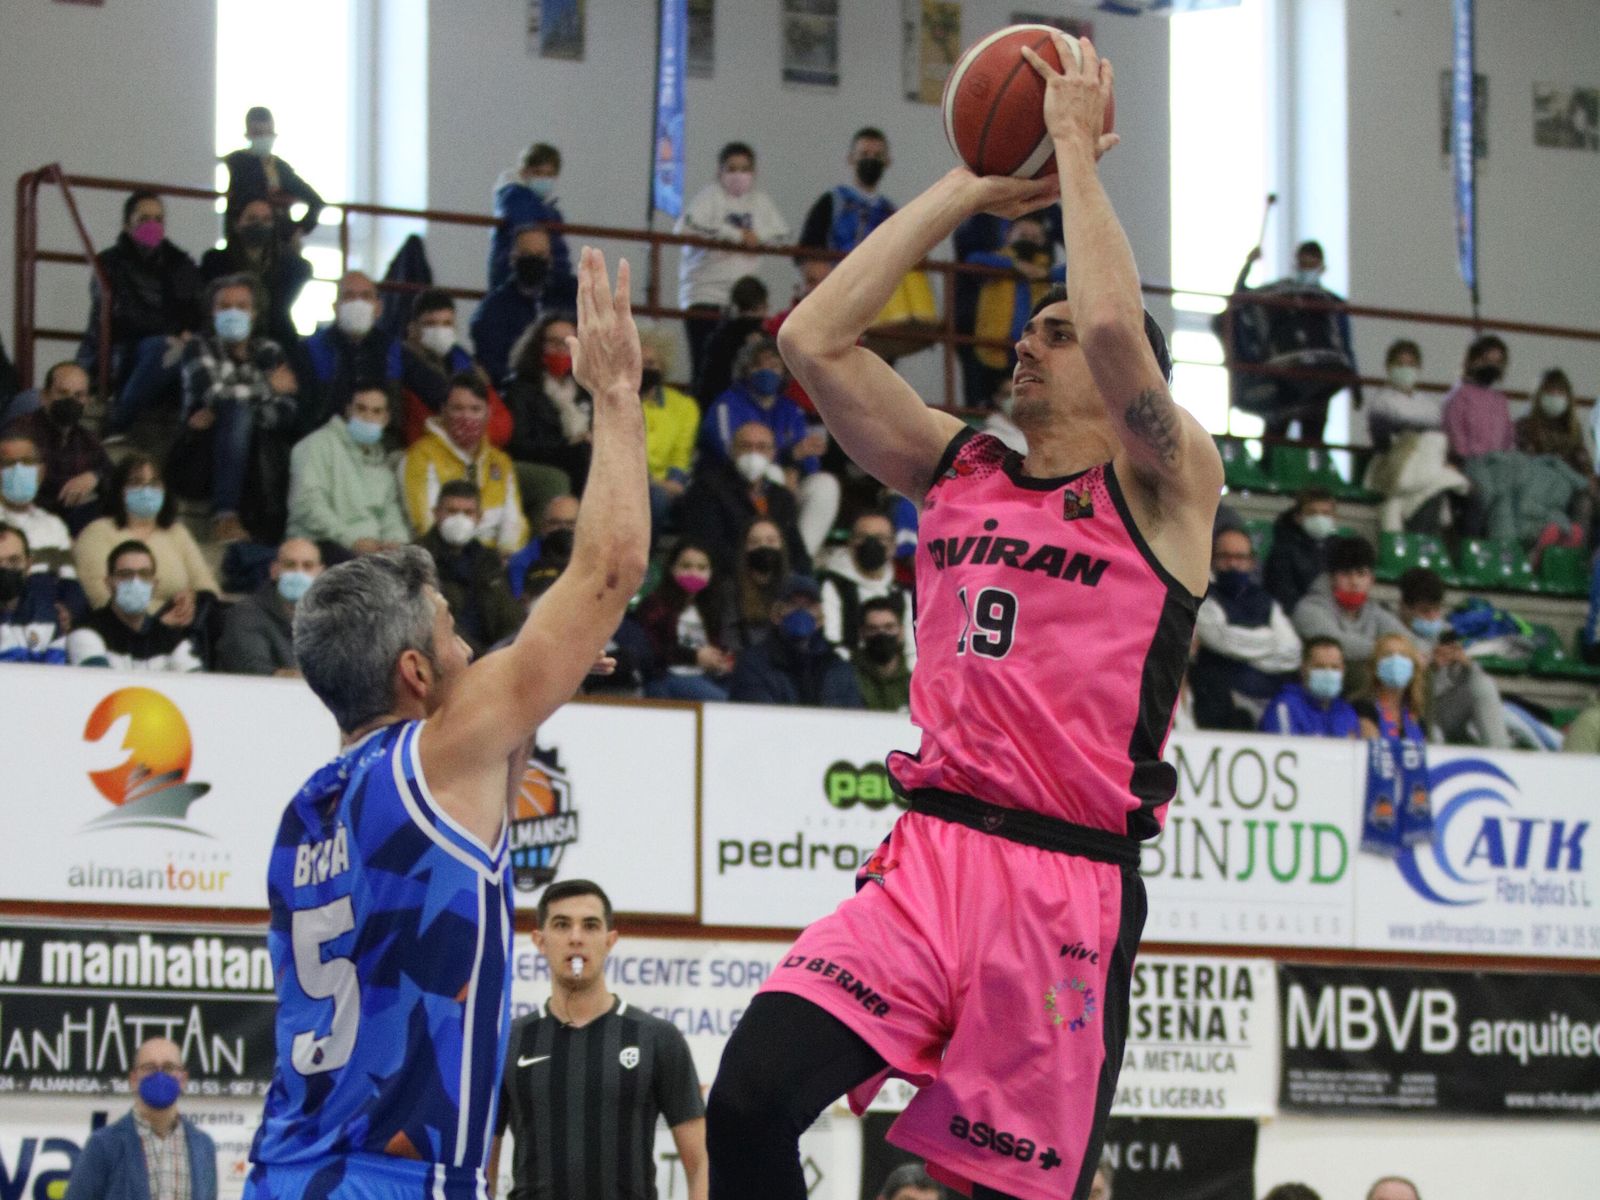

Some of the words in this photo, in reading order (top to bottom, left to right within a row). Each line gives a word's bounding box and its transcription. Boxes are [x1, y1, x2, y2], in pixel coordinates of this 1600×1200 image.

[825, 760, 894, 810] pa
[1464, 816, 1590, 873] ATK
[42, 934, 275, 990] manhattan
[292, 895, 361, 1075] 5
[806, 957, 891, 1018] BERNER
[1131, 963, 1254, 1001] STERIA
[1127, 1003, 1228, 1042] SENA
[1287, 983, 1459, 1053] MBVB
[949, 1114, 1036, 1163] asisa
